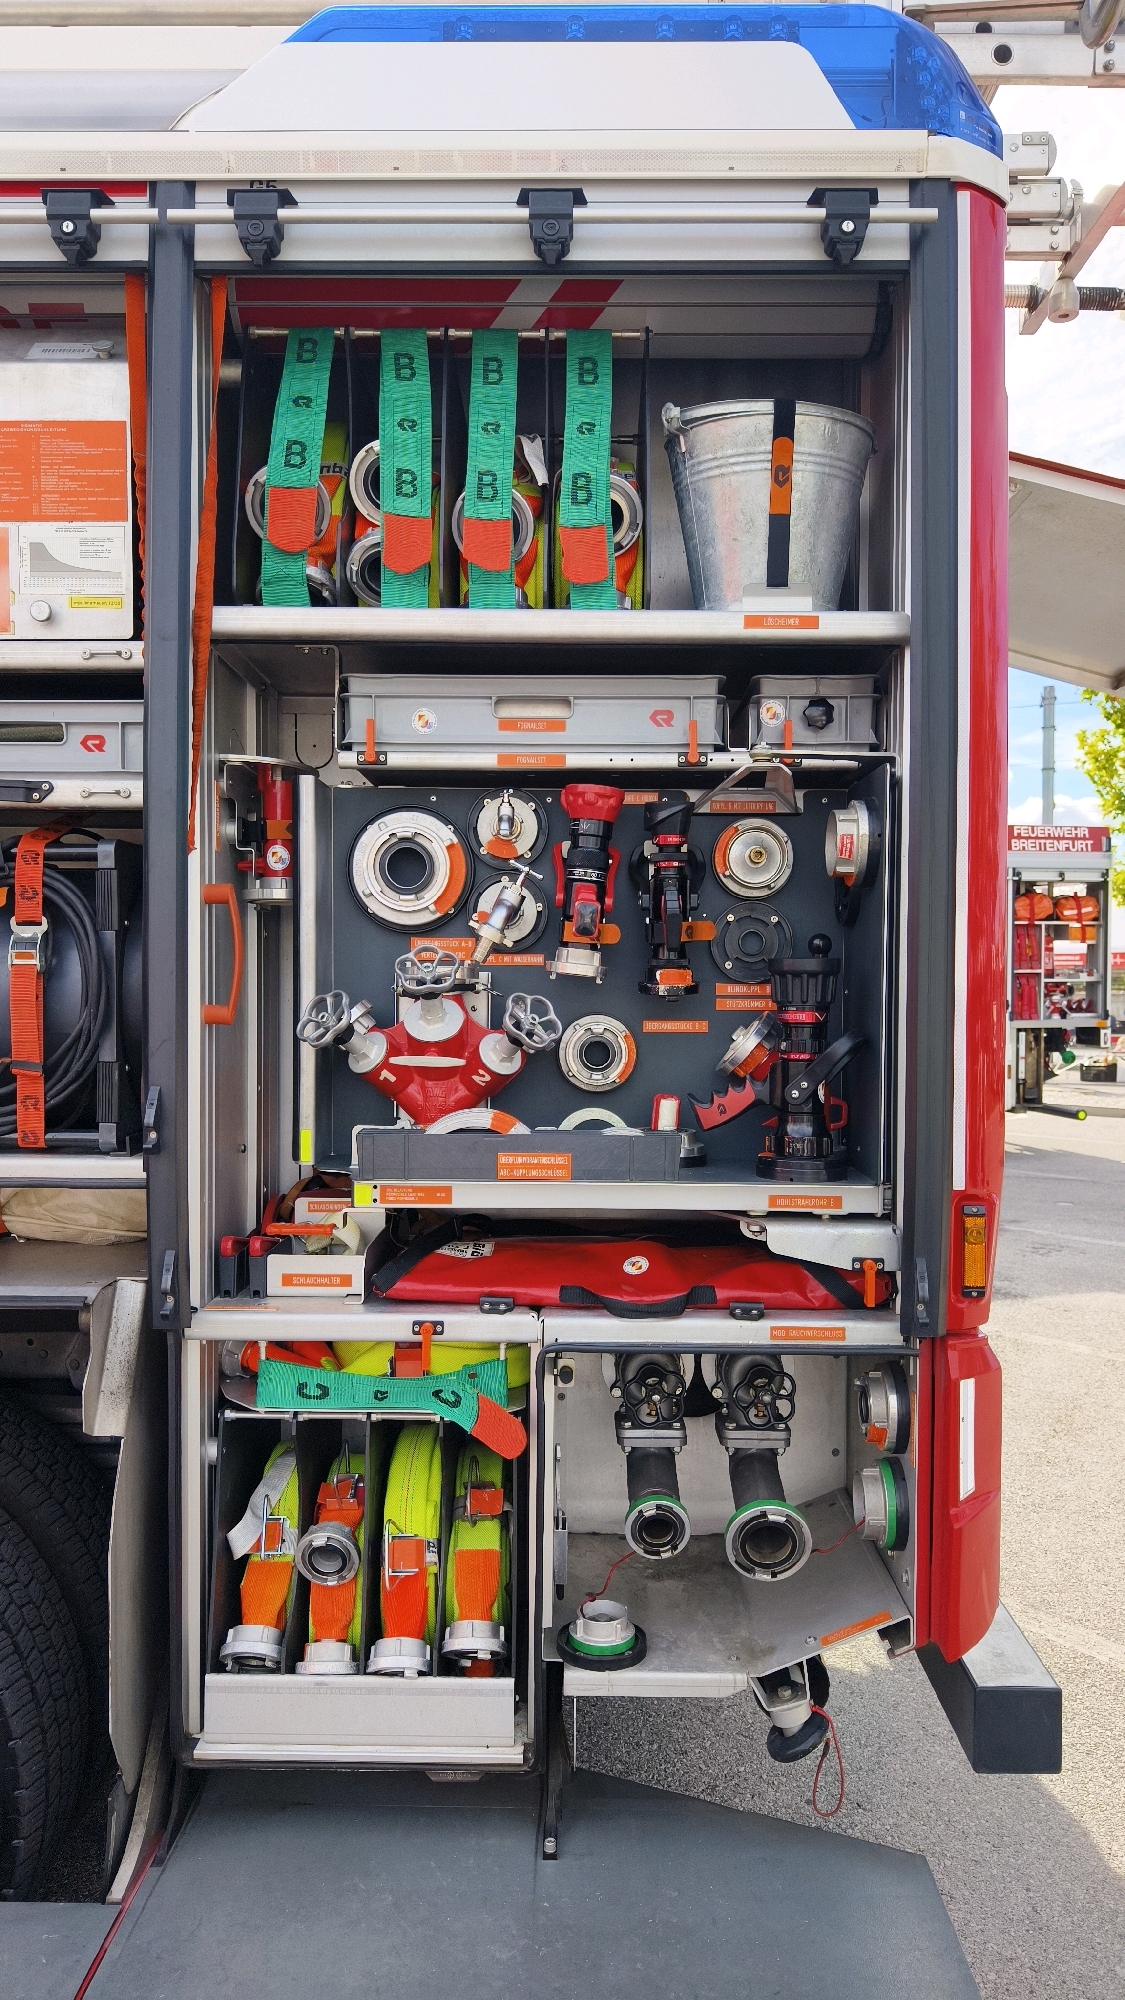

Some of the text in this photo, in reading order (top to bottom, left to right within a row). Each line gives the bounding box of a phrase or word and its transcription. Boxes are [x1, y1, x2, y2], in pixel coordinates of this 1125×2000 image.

[296, 338, 318, 363] B
[393, 353, 416, 381] B
[482, 356, 503, 385] B
[577, 357, 599, 385] B
[283, 439, 307, 469] B
[395, 467, 418, 499] B
[477, 470, 498, 502] B
[571, 472, 592, 506] B
[763, 616, 800, 627] LÖSCHEIMER
[517, 721, 547, 730] FOGNAILSET
[516, 756, 547, 764] FOGNAILSET
[1013, 826, 1089, 838] FEUERWEHR
[1011, 839, 1093, 852] BREITENFURT
[461, 940, 472, 948] A-B
[726, 1000, 766, 1008] STÜTZKRÜMMER
[645, 1021, 693, 1030] ÜBERGANGSSTÜCKE
[378, 1069, 397, 1083] 1
[471, 1069, 492, 1087] 2
[499, 1168, 569, 1177] ABC-KUPPLUNGSSCHLÜSSEL
[776, 1198, 828, 1207] HOHLSTRAHLROHR
[292, 1276, 341, 1285] SCHLAUCHHALTER
[296, 1381, 330, 1401] C
[431, 1388, 462, 1409] C
